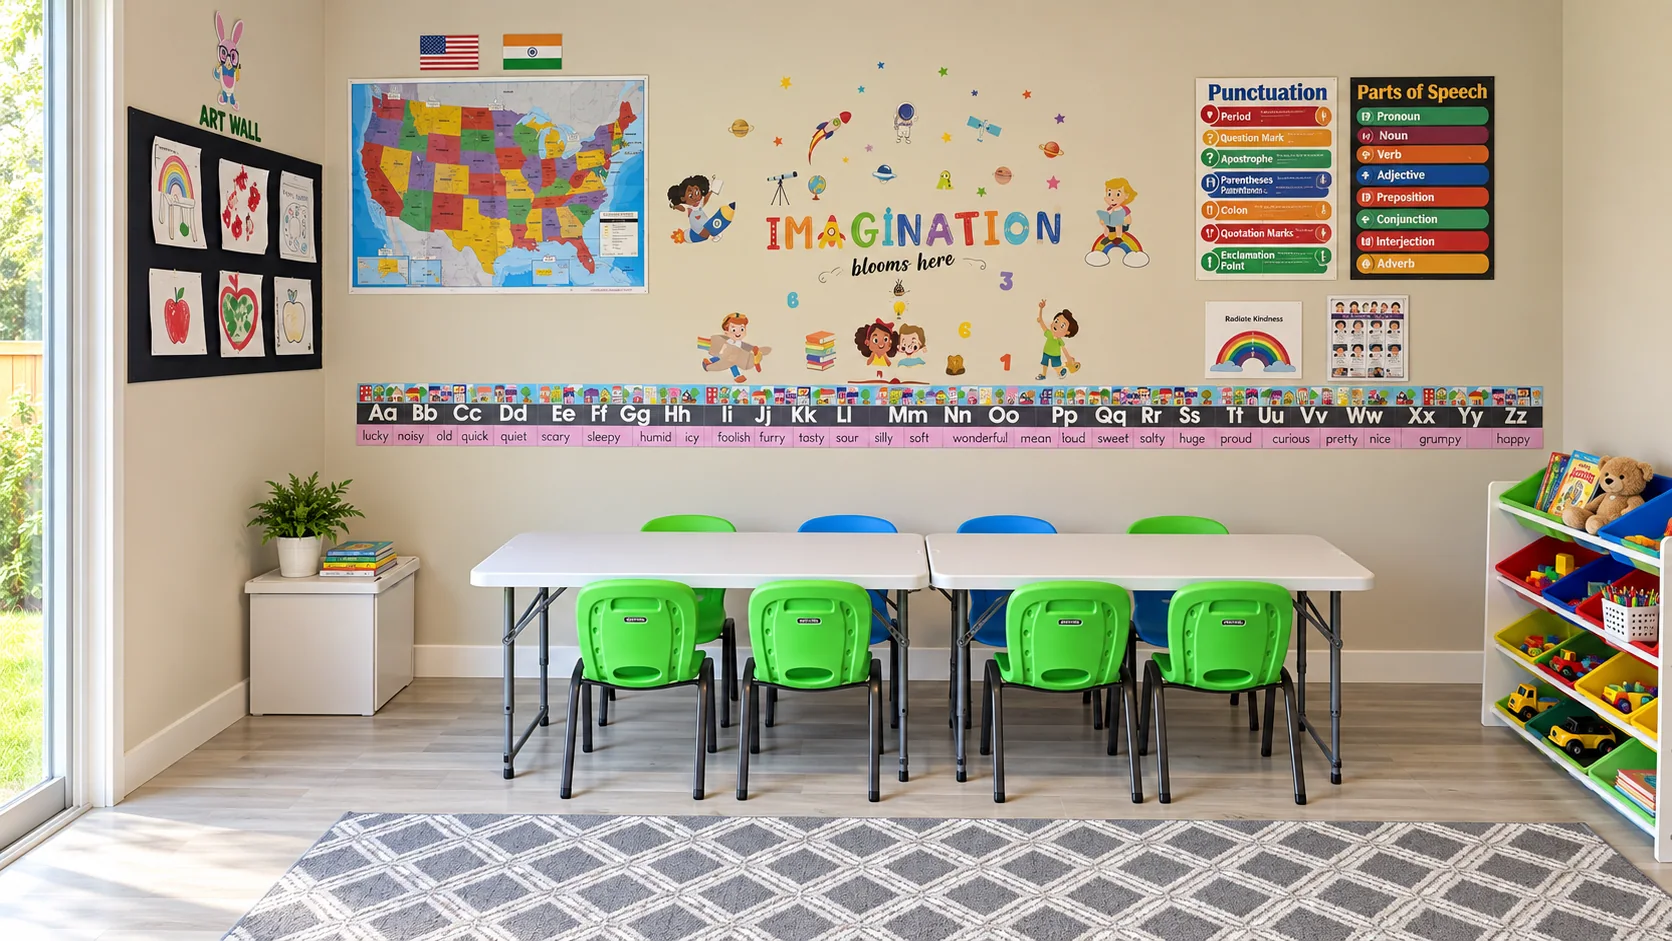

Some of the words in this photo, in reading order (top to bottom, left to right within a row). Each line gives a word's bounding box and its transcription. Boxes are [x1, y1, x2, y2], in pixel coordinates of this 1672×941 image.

[1208, 82, 1328, 101] Punctuation
[1357, 84, 1402, 100] Parts
[1406, 83, 1424, 99] of
[1427, 83, 1488, 103] Speech
[1221, 112, 1251, 121] Period
[1377, 111, 1421, 121] Pronoun
[199, 104, 226, 132] ART
[229, 113, 262, 143] WALL
[1220, 133, 1259, 143] Question
[1261, 133, 1284, 142] Mark
[1379, 130, 1408, 140] Noun
[1221, 154, 1273, 165] Apostrophe
[1377, 149, 1402, 160] Verb
[1221, 176, 1273, 184] Parentheses
[1377, 169, 1426, 183] Adjective
[1377, 191, 1435, 204] Preposition
[1220, 206, 1248, 215] Colon
[1376, 213, 1438, 226] Conjunction
[1220, 228, 1265, 238] Quotation
[1267, 228, 1294, 237] Marks
[1376, 235, 1435, 248] Interjection
[1221, 250, 1275, 259] Exclamation
[851, 257, 909, 277] blooms
[917, 252, 956, 272] here
[1221, 262, 1245, 270] Point
[1377, 258, 1415, 268] Adverb
[999, 271, 1014, 291] 3
[1253, 315, 1283, 323] Kindness
[958, 321, 972, 339] 6
[1000, 353, 1012, 371] 1
[369, 404, 397, 421] Aa
[413, 404, 437, 421] Bb
[454, 404, 481, 422] Cc
[500, 404, 527, 422] Dd
[552, 404, 576, 422] Ee
[592, 404, 607, 422] Ff
[620, 404, 650, 427] Gg
[664, 404, 691, 422] Hh
[722, 405, 733, 422] Ii
[755, 405, 771, 427] Jj
[792, 405, 817, 422] Kk
[837, 405, 851, 423] Ll
[888, 405, 928, 423] Mm
[945, 405, 971, 423] Nn
[989, 405, 1020, 423] Oo
[1052, 405, 1078, 428] Pp
[1095, 406, 1127, 428] Qq
[1141, 406, 1162, 423] Rr
[1180, 406, 1200, 423] Ss
[1227, 406, 1243, 423] Tt
[1259, 406, 1284, 424] Uu
[1300, 406, 1328, 424] Vv
[1346, 406, 1383, 424] Ww
[1408, 406, 1435, 424] Xx
[1458, 406, 1483, 429] Yy
[1505, 407, 1527, 424] Zz
[363, 430, 389, 443] lucky
[398, 431, 424, 443] noisy
[437, 430, 452, 441] old
[462, 431, 488, 444] quick
[501, 432, 526, 444] quiet
[542, 434, 570, 444] scary
[588, 431, 620, 444] sleepy
[641, 431, 671, 442] humid
[684, 431, 700, 445] icy
[718, 432, 750, 442] foolish
[760, 431, 785, 445] furry
[799, 433, 824, 445] tasty
[836, 435, 859, 443] sour
[875, 432, 893, 445] silly
[910, 432, 929, 442] soft
[1098, 434, 1129, 443] sweet
[1140, 433, 1165, 445] salty
[1180, 433, 1205, 446] huge
[1221, 432, 1251, 446] proud
[1273, 433, 1310, 443] curious
[1326, 434, 1358, 446] pretty
[1370, 434, 1390, 443] nice
[1420, 437, 1461, 446] grumpy
[1497, 433, 1530, 446] happy
